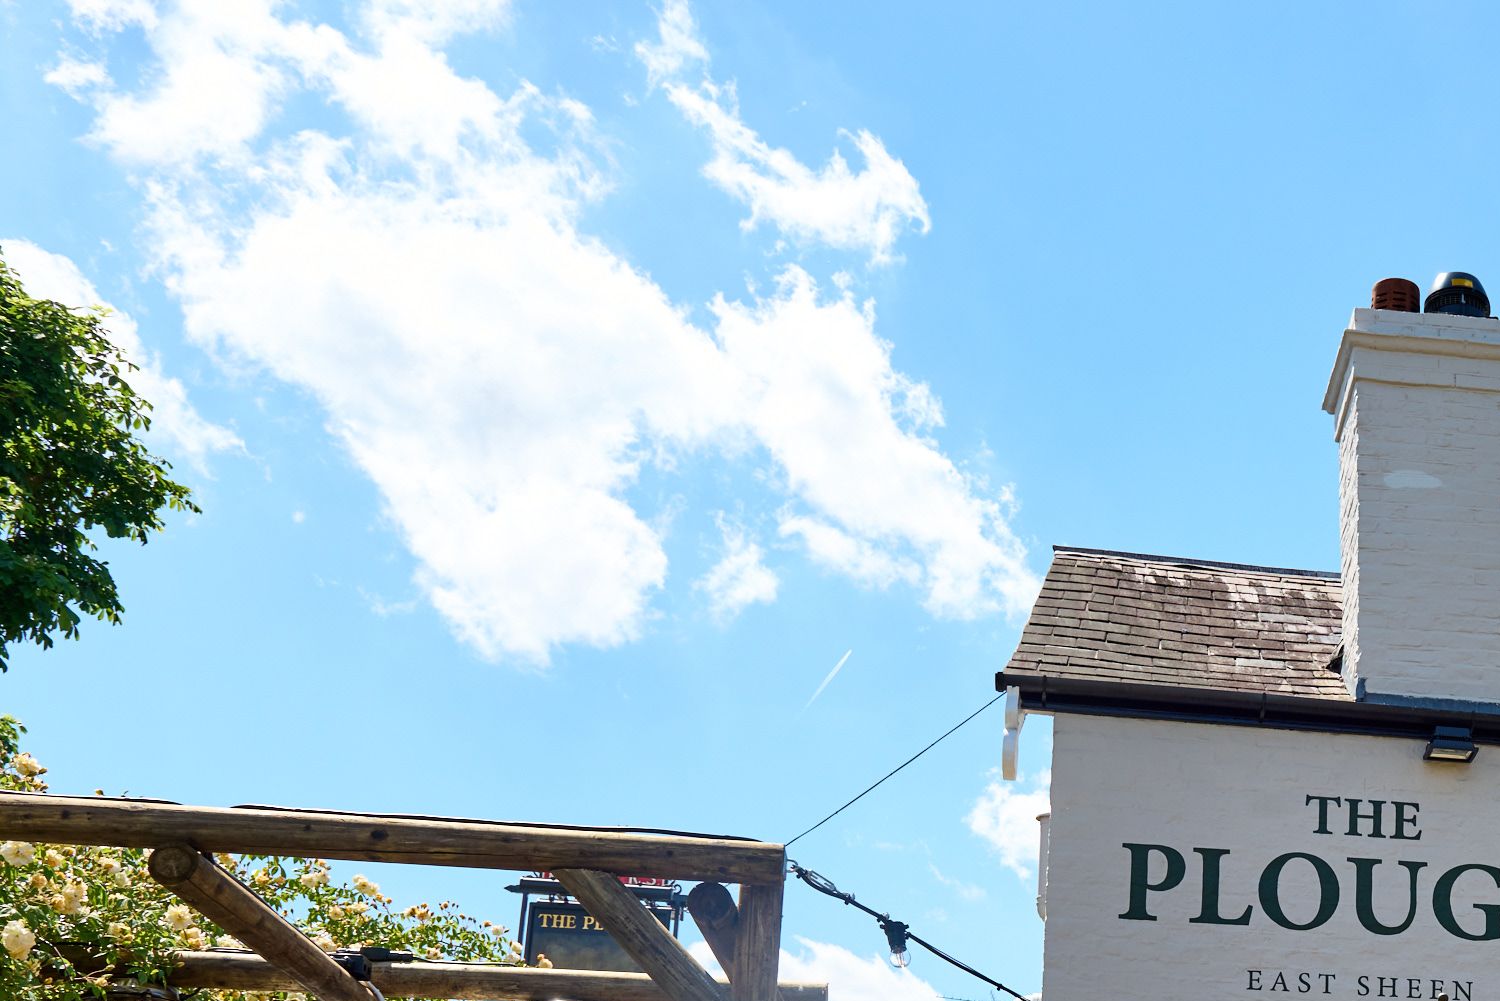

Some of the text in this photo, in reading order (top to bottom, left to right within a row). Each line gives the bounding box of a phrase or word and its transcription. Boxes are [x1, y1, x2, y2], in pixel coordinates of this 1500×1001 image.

[1305, 794, 1422, 841] THE
[538, 913, 577, 929] THE
[1246, 969, 1474, 1001] EAST SHEEN
